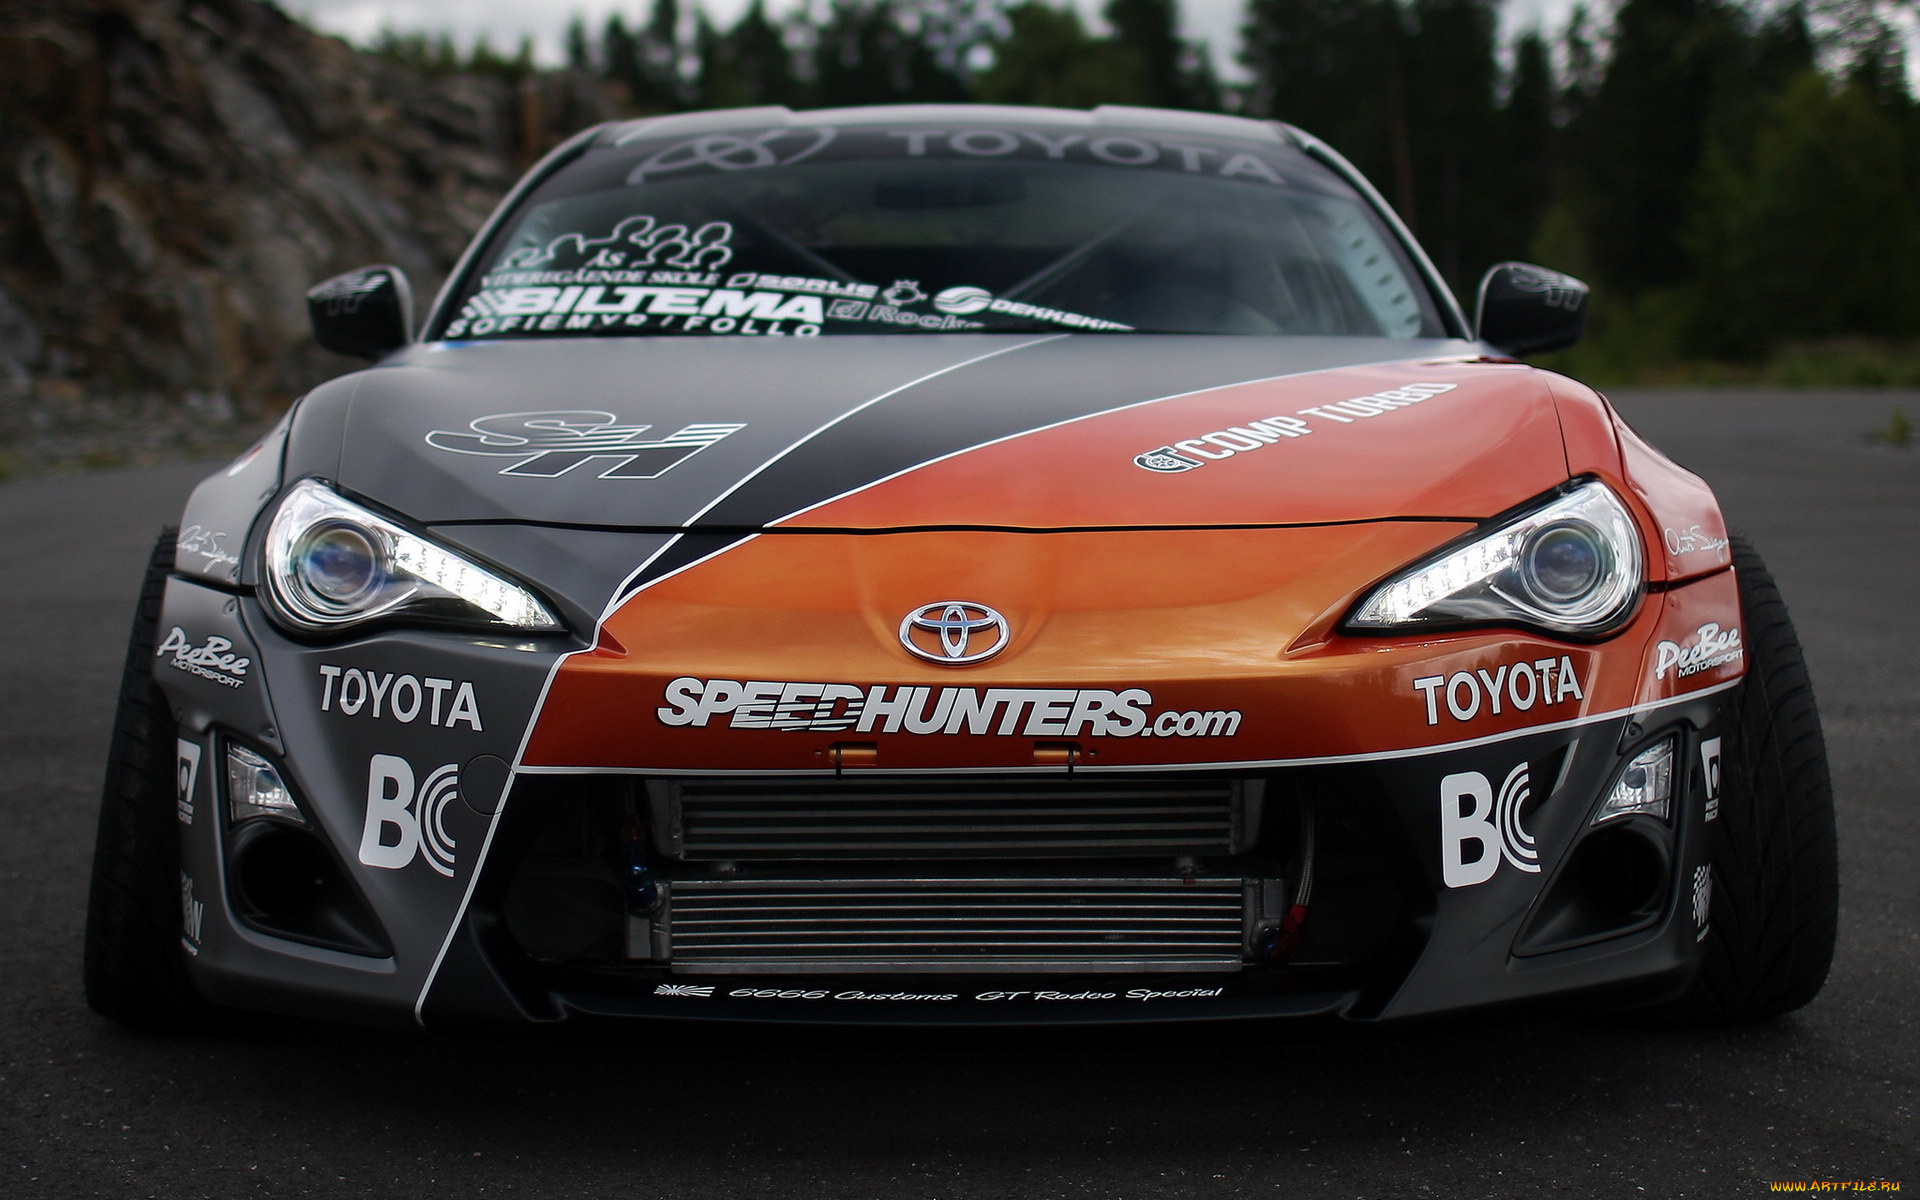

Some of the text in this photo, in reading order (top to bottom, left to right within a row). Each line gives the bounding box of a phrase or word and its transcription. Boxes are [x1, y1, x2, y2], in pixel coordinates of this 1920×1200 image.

[888, 130, 1286, 185] TOYOTA
[497, 286, 824, 324] BILTEMA
[648, 271, 721, 286] SKOLE
[683, 316, 821, 338] FOLLO
[1173, 415, 1312, 461] COMP
[1296, 382, 1459, 424] TURBO
[156, 625, 250, 676] PeeBee
[170, 657, 245, 689] MOTORSPORT
[1655, 622, 1741, 681] PeeBee
[1678, 648, 1744, 679] MOTORSPORT
[319, 664, 483, 732] TOYOTA
[657, 676, 1243, 738] SPEEDHUNTERS.com
[1413, 655, 1584, 726] TOYOTA
[358, 753, 459, 878] BC
[1440, 761, 1542, 889] BC
[729, 988, 830, 999] 6666
[834, 990, 958, 1001] Customs
[1034, 991, 1117, 1001] Rodeo
[1125, 987, 1223, 1001] Special
